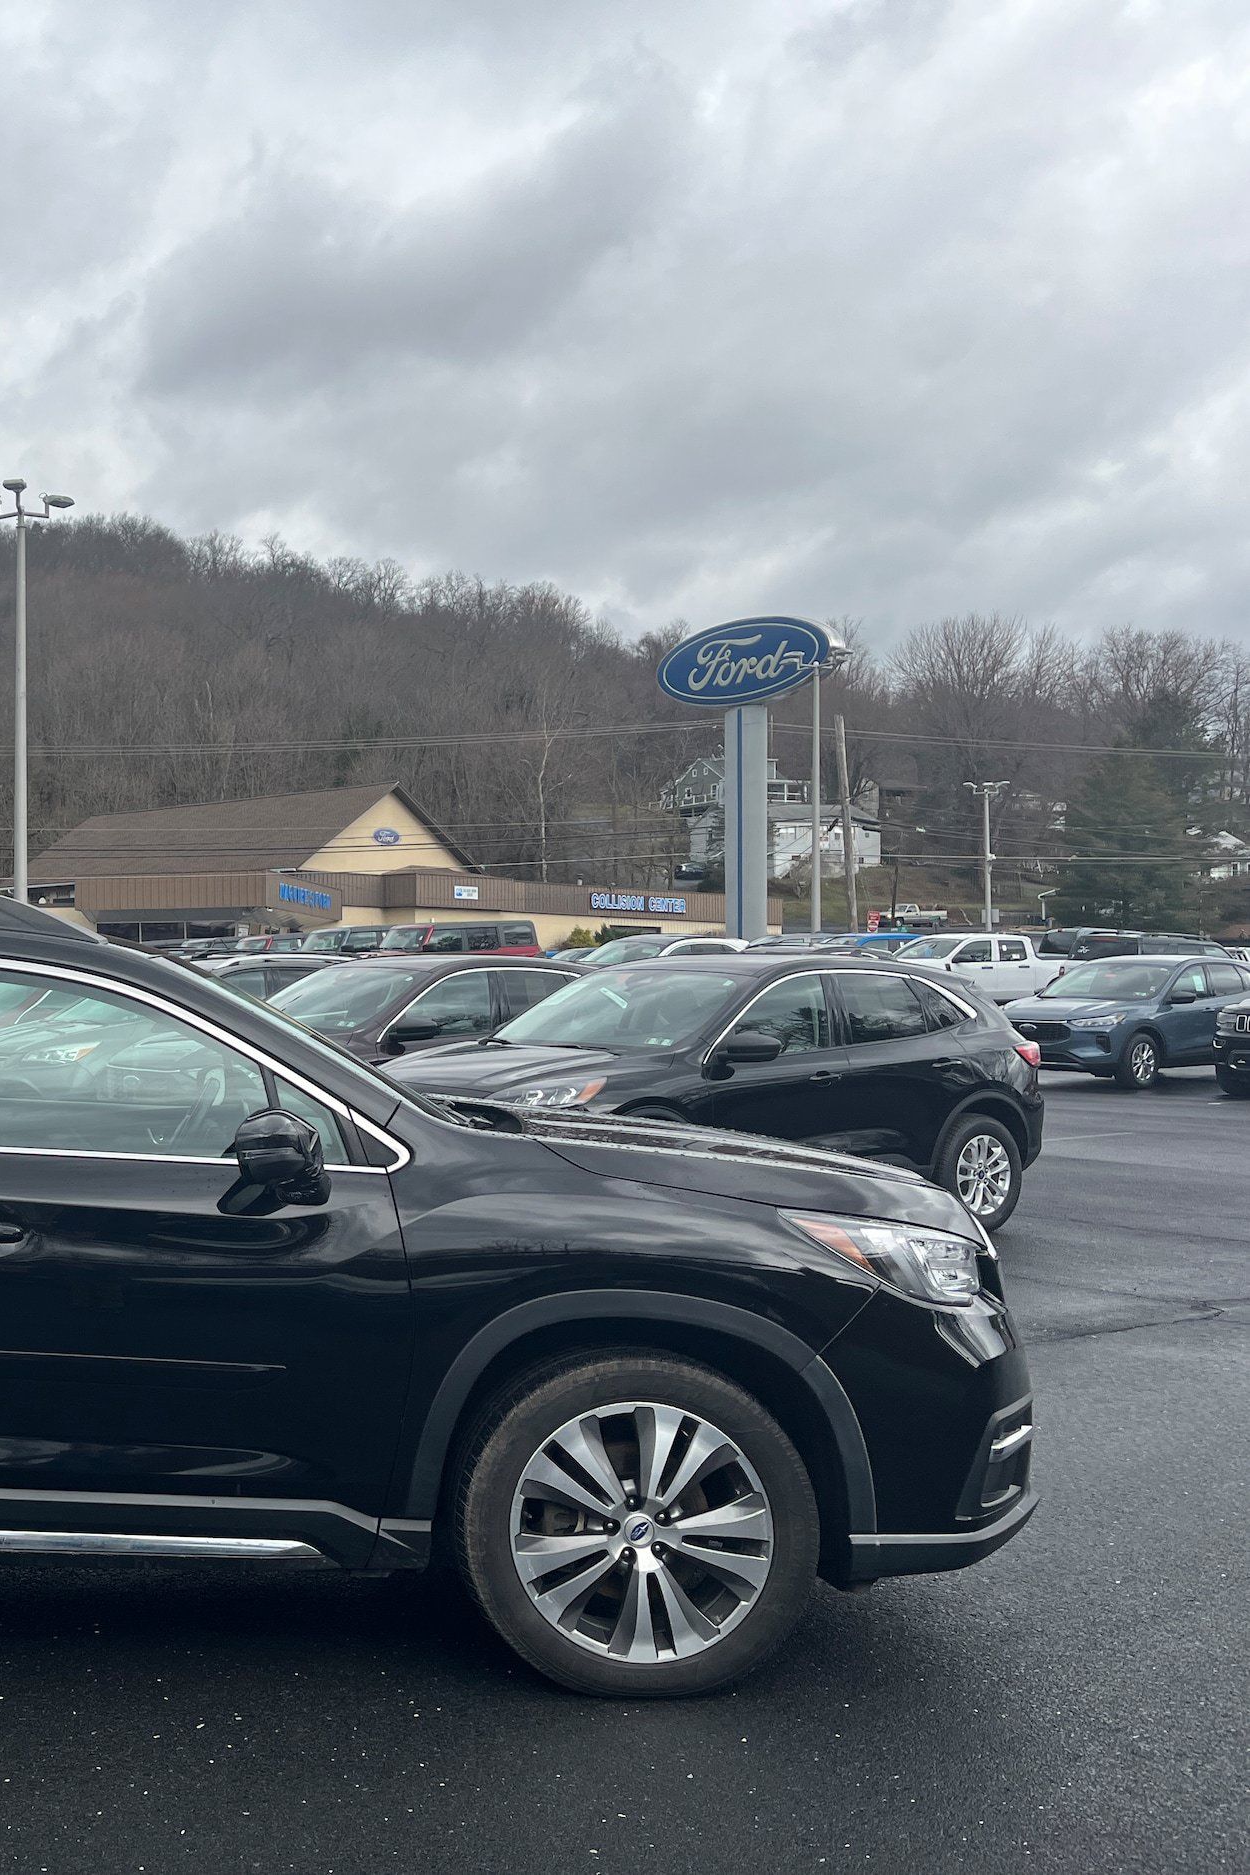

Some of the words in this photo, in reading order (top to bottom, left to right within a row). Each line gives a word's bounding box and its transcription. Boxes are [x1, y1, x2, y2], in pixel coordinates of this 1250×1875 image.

[687, 633, 789, 691] Ford
[591, 893, 645, 911] COLLISION
[649, 896, 686, 913] CENTER
